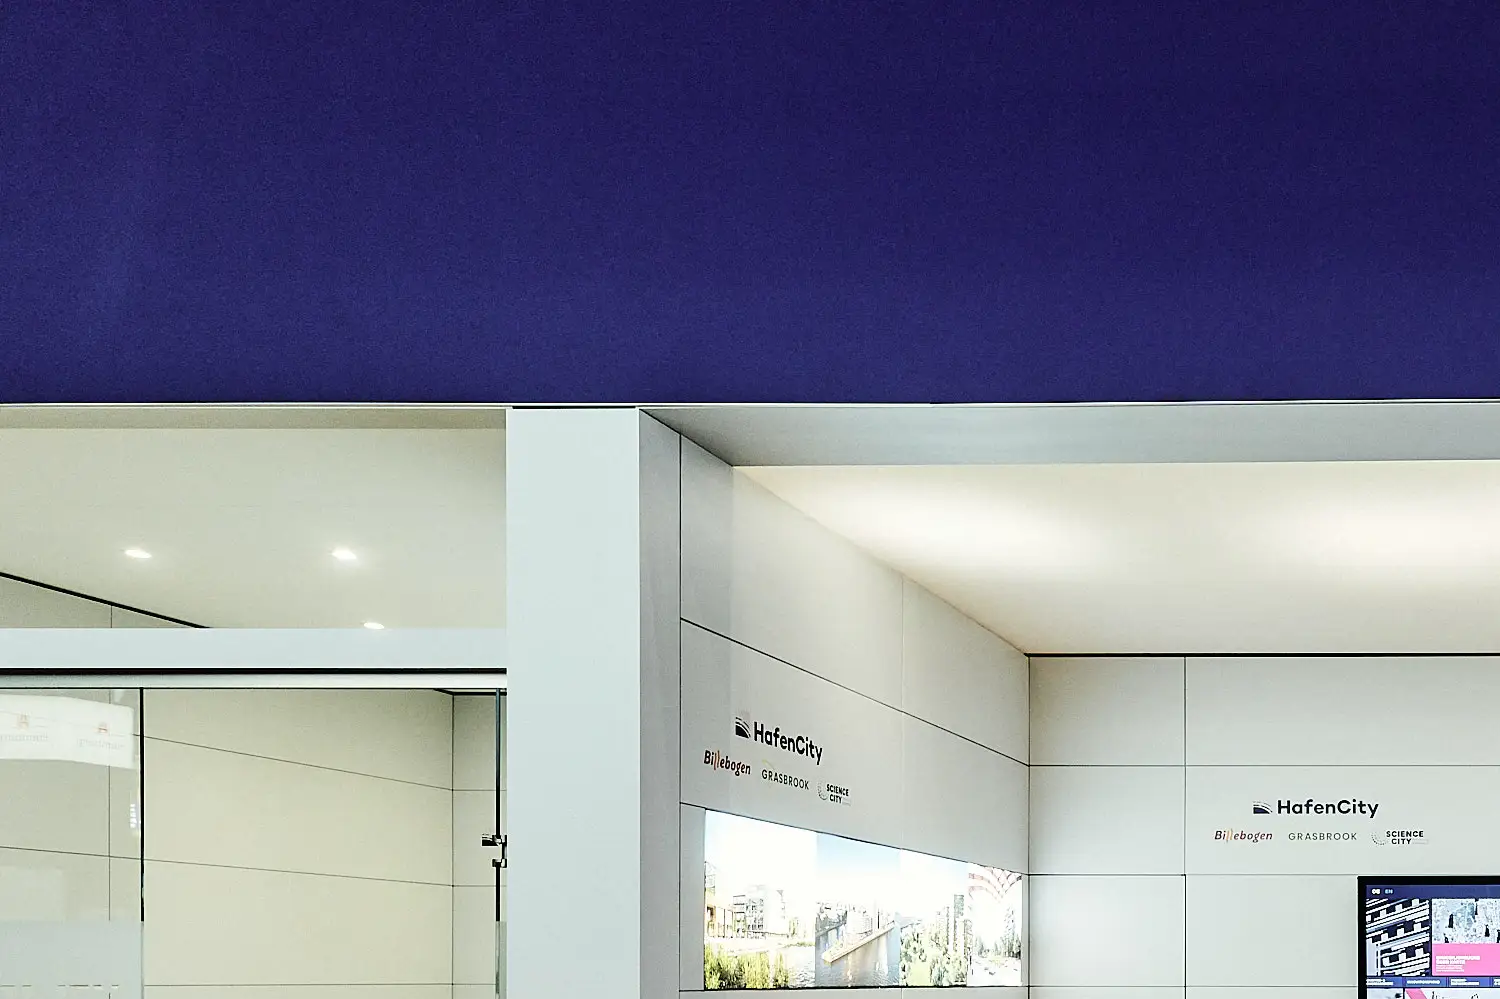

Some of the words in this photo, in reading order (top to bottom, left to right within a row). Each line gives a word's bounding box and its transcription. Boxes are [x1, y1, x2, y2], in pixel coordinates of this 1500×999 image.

[754, 721, 823, 766] HafenCity
[703, 749, 751, 777] Billebogen
[761, 769, 809, 790] GRASBROOK
[826, 783, 850, 797] SCIENCE
[829, 794, 842, 804] CITY
[1277, 798, 1379, 818] HafenCity
[1214, 828, 1273, 844] Billebogen
[1288, 832, 1358, 841] GRASBROOK
[1386, 830, 1424, 838] SCIENCE
